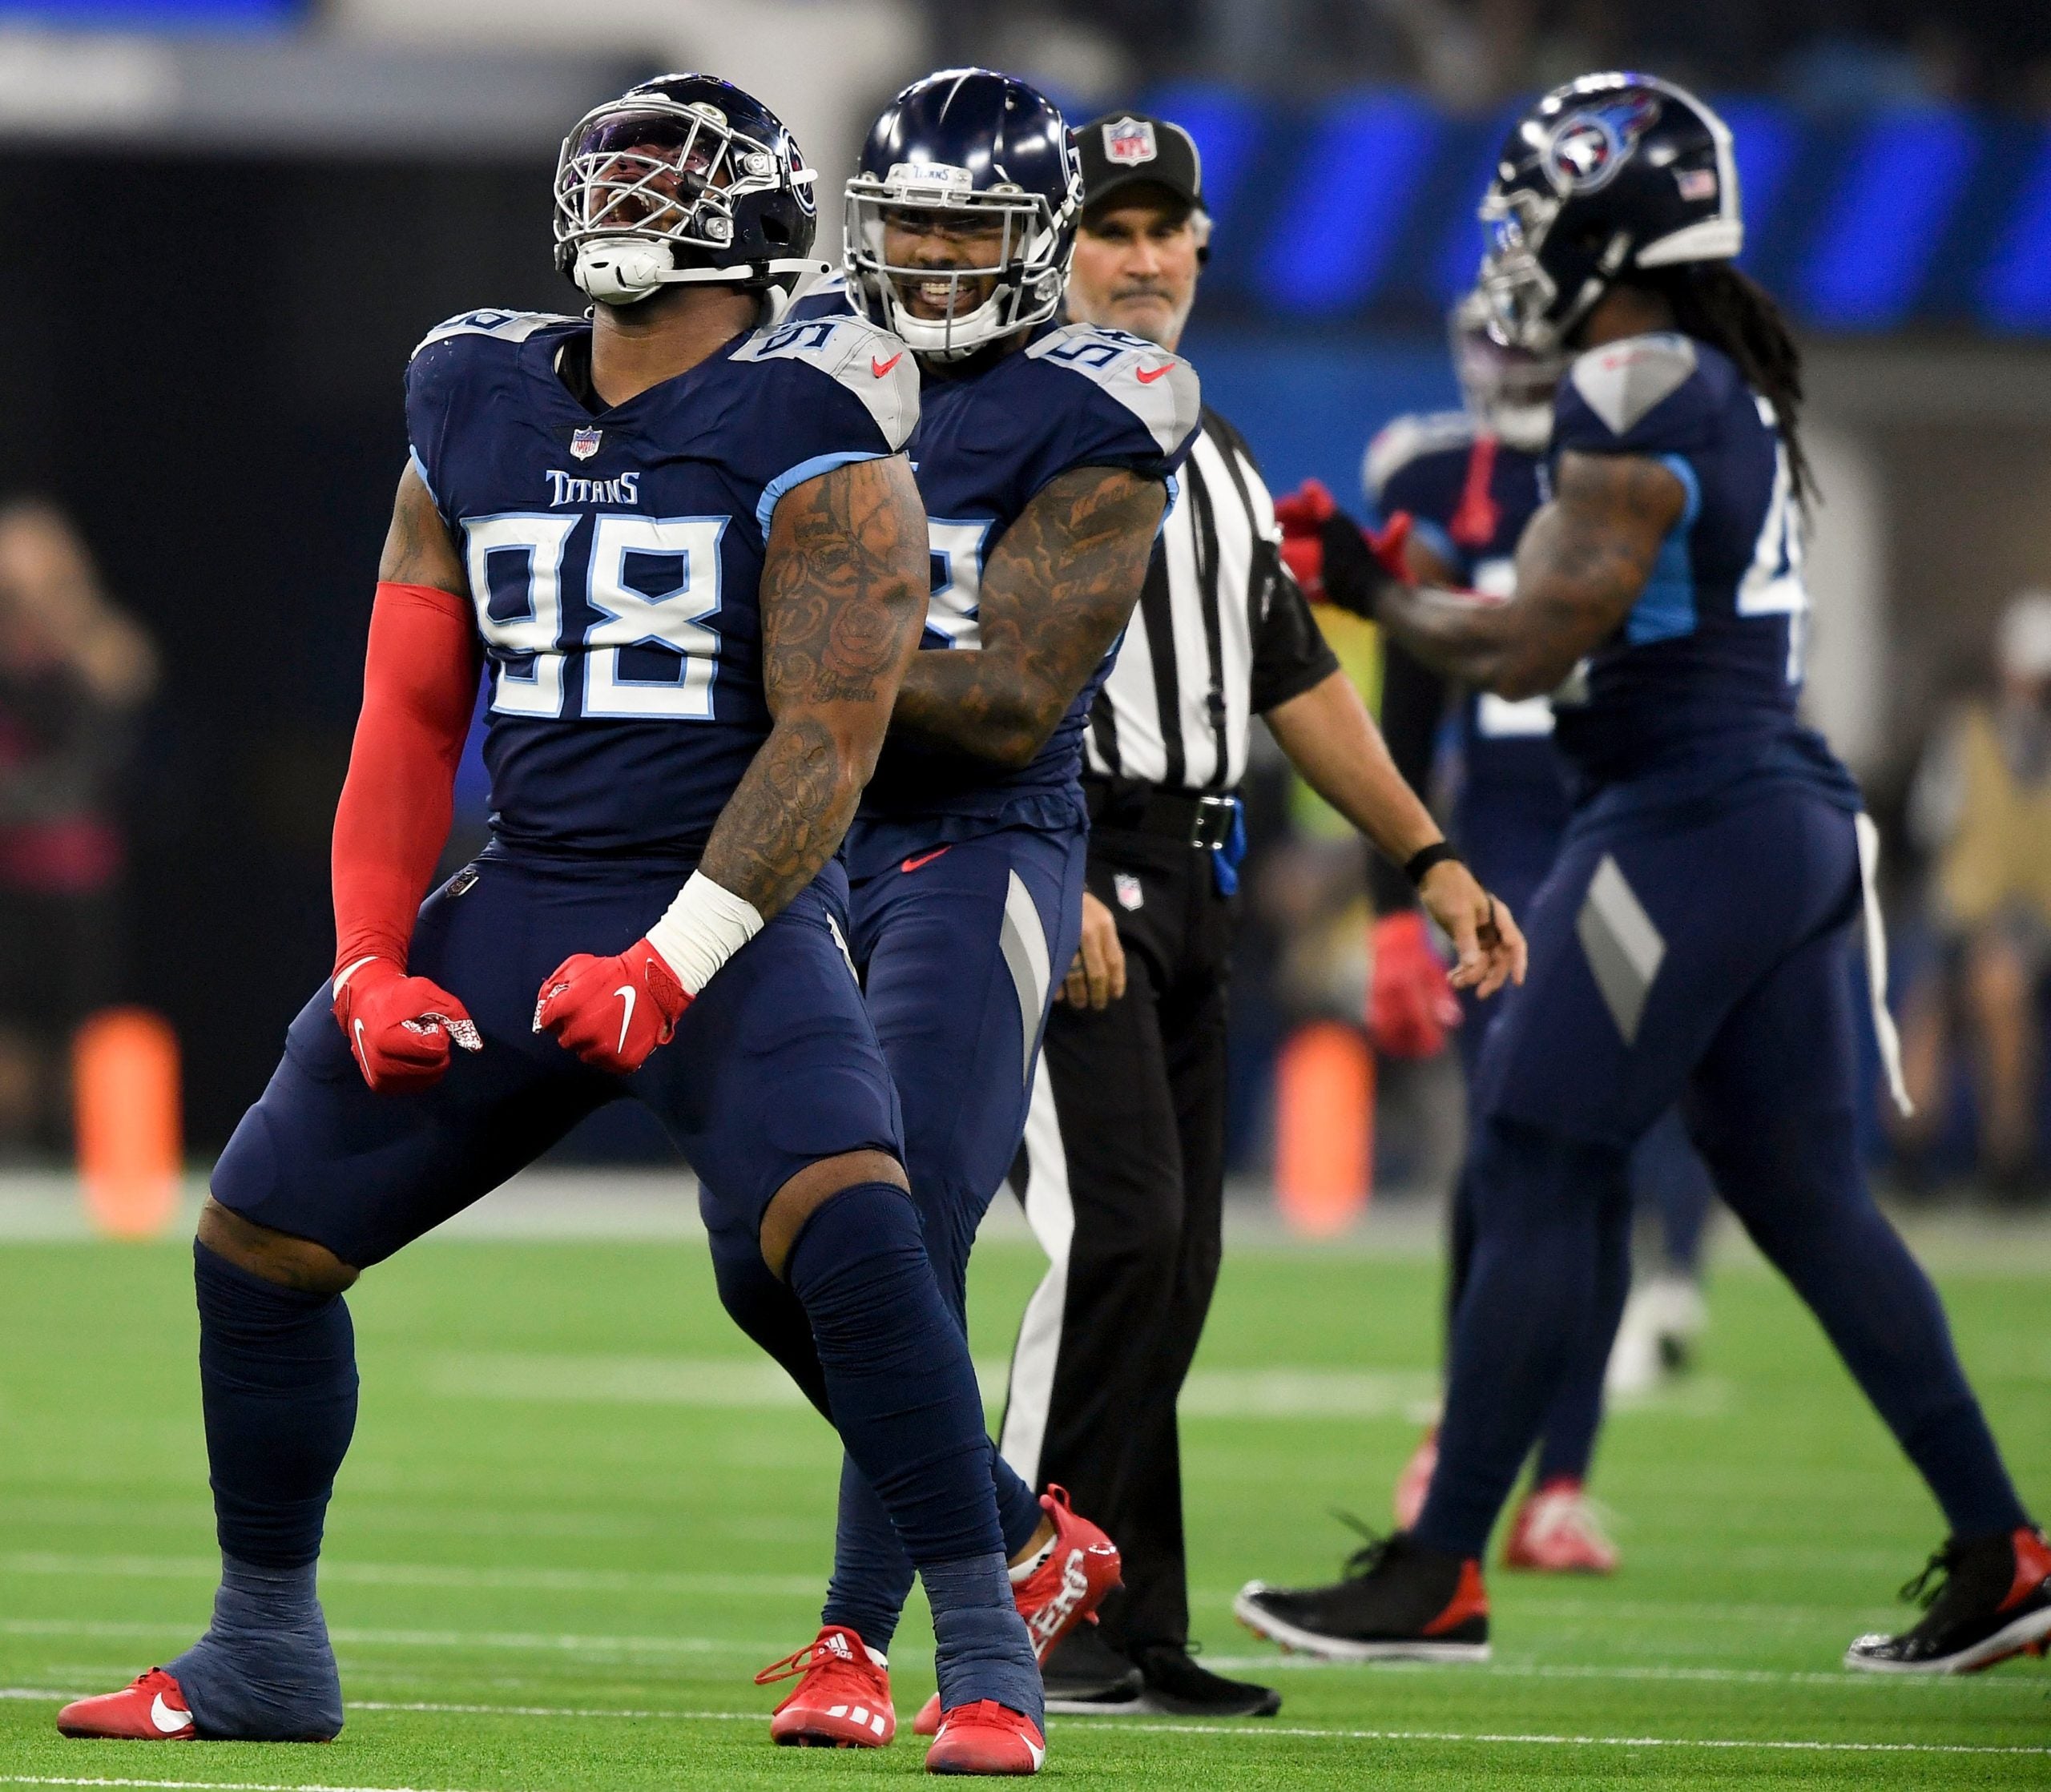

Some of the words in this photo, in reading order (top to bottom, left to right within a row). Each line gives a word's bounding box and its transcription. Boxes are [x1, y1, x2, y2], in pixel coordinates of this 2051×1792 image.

[913, 165, 949, 181] TIANS
[546, 470, 640, 507] TITANS
[460, 513, 733, 720] 98
[818, 1647, 853, 1661] adas
